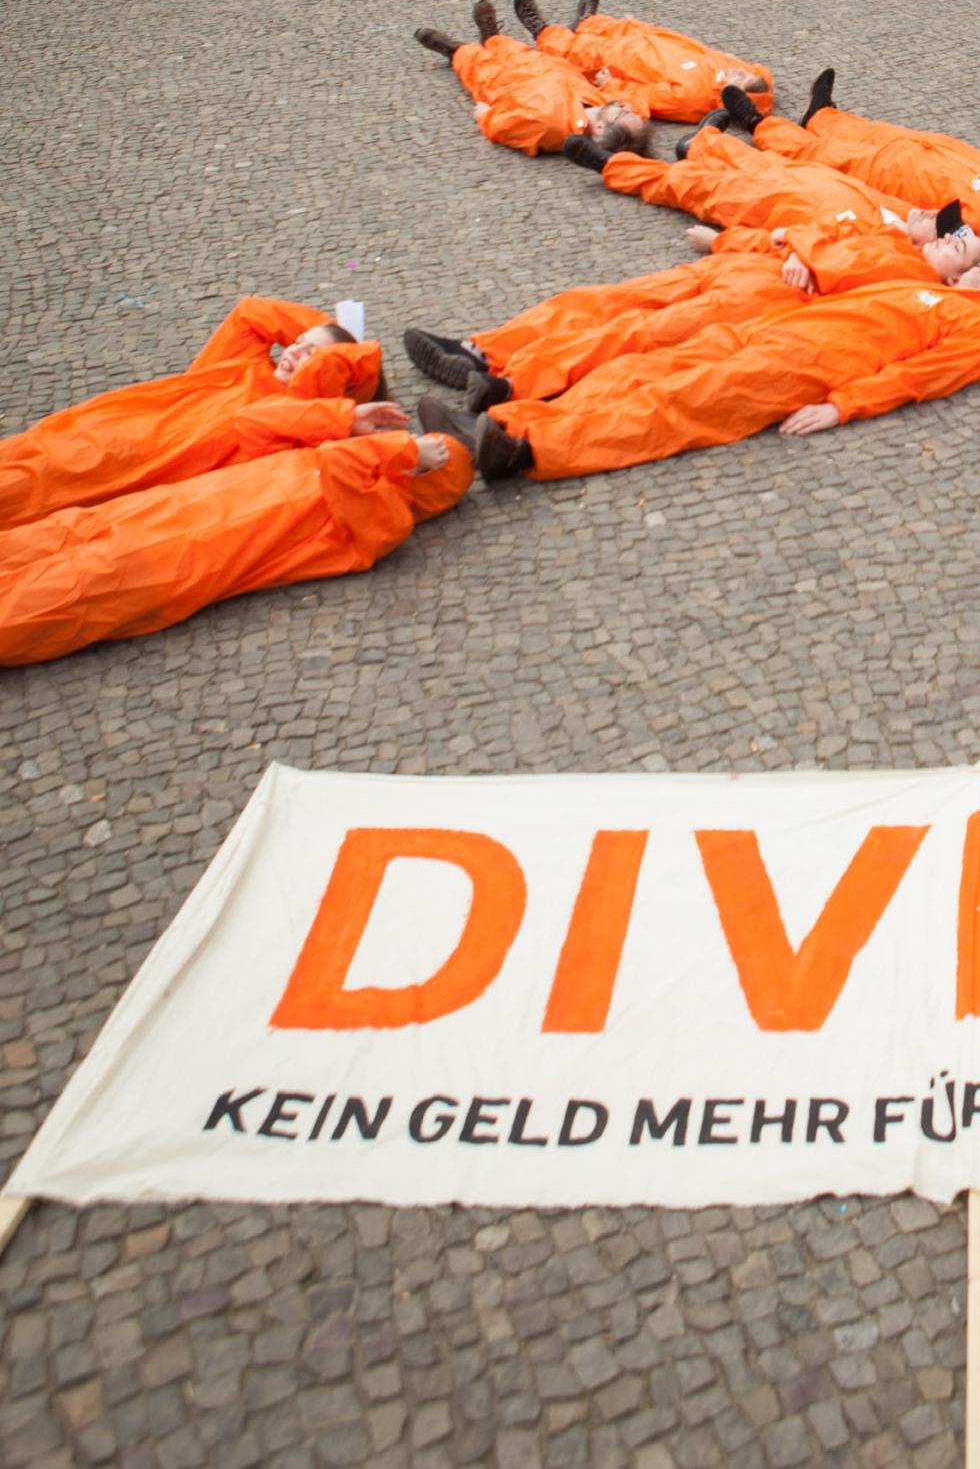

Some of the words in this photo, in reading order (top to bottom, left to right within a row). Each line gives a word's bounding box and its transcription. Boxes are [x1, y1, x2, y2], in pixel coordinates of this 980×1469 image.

[203, 1088, 392, 1141] KEIN
[408, 1096, 608, 1147] GELD
[629, 1098, 849, 1146] MEHR
